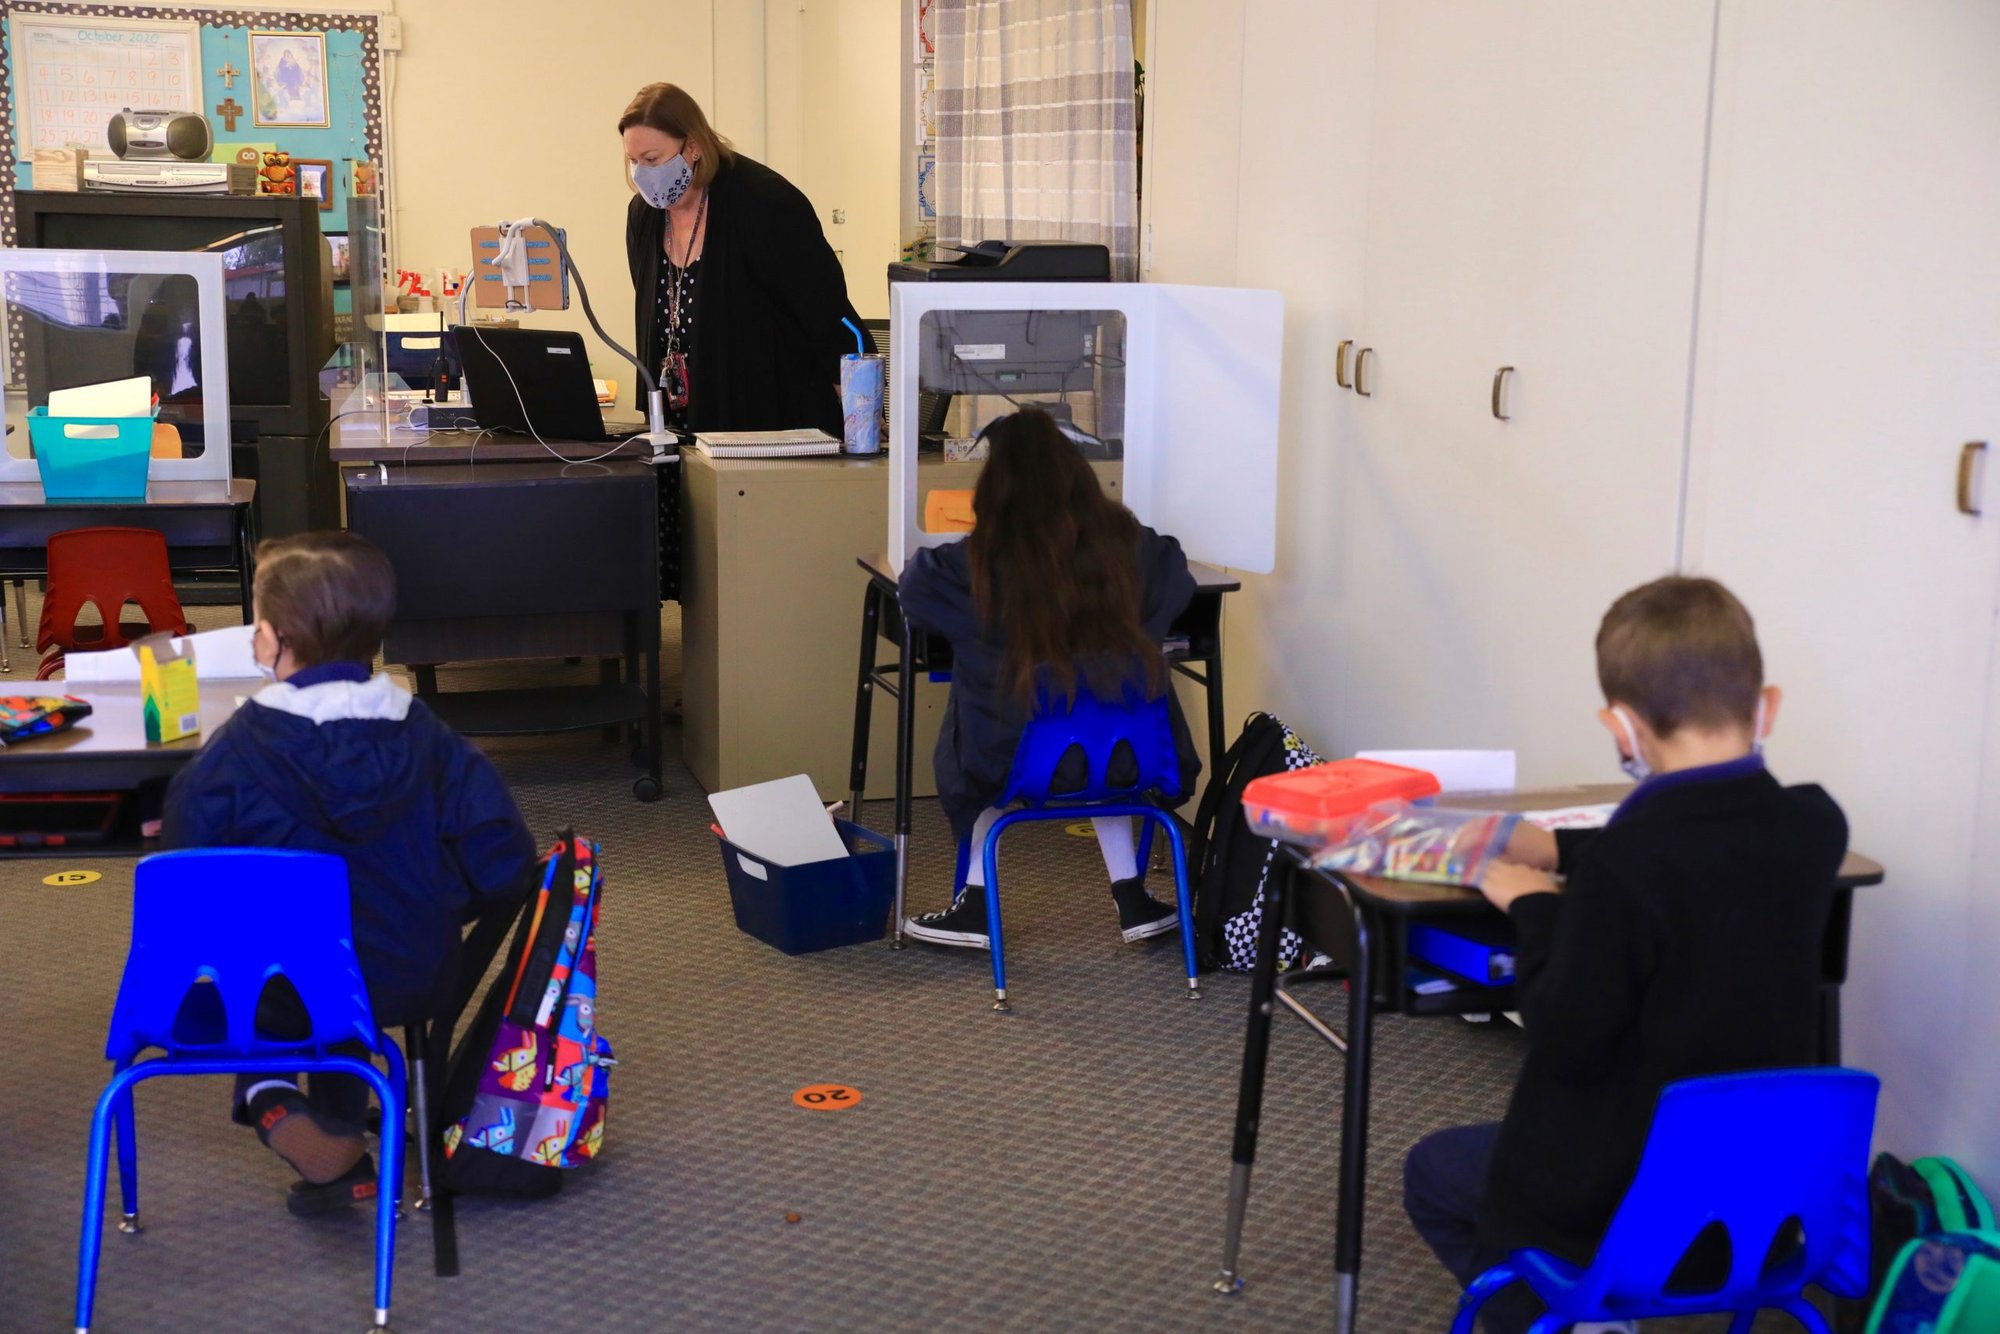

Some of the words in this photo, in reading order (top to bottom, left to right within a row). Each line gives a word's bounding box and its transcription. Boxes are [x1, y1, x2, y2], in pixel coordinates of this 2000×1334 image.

[77, 30, 124, 43] October
[129, 32, 160, 44] 2020
[148, 52, 158, 66] 2
[168, 50, 180, 66] 3
[39, 66, 48, 81] 4
[60, 67, 74, 82] 5
[83, 70, 94, 84] 6
[104, 69, 117, 86] 7
[127, 70, 137, 86] 8
[147, 69, 158, 86] 9
[168, 74, 181, 86] 10
[61, 88, 75, 102] 12
[83, 89, 97, 102] 13
[104, 90, 117, 104] 14
[125, 91, 140, 104] 15
[147, 92, 160, 105] 16
[41, 109, 52, 123] 18
[63, 109, 75, 123] 19
[39, 129, 56, 143] 25
[803, 1089, 850, 1103] 20
